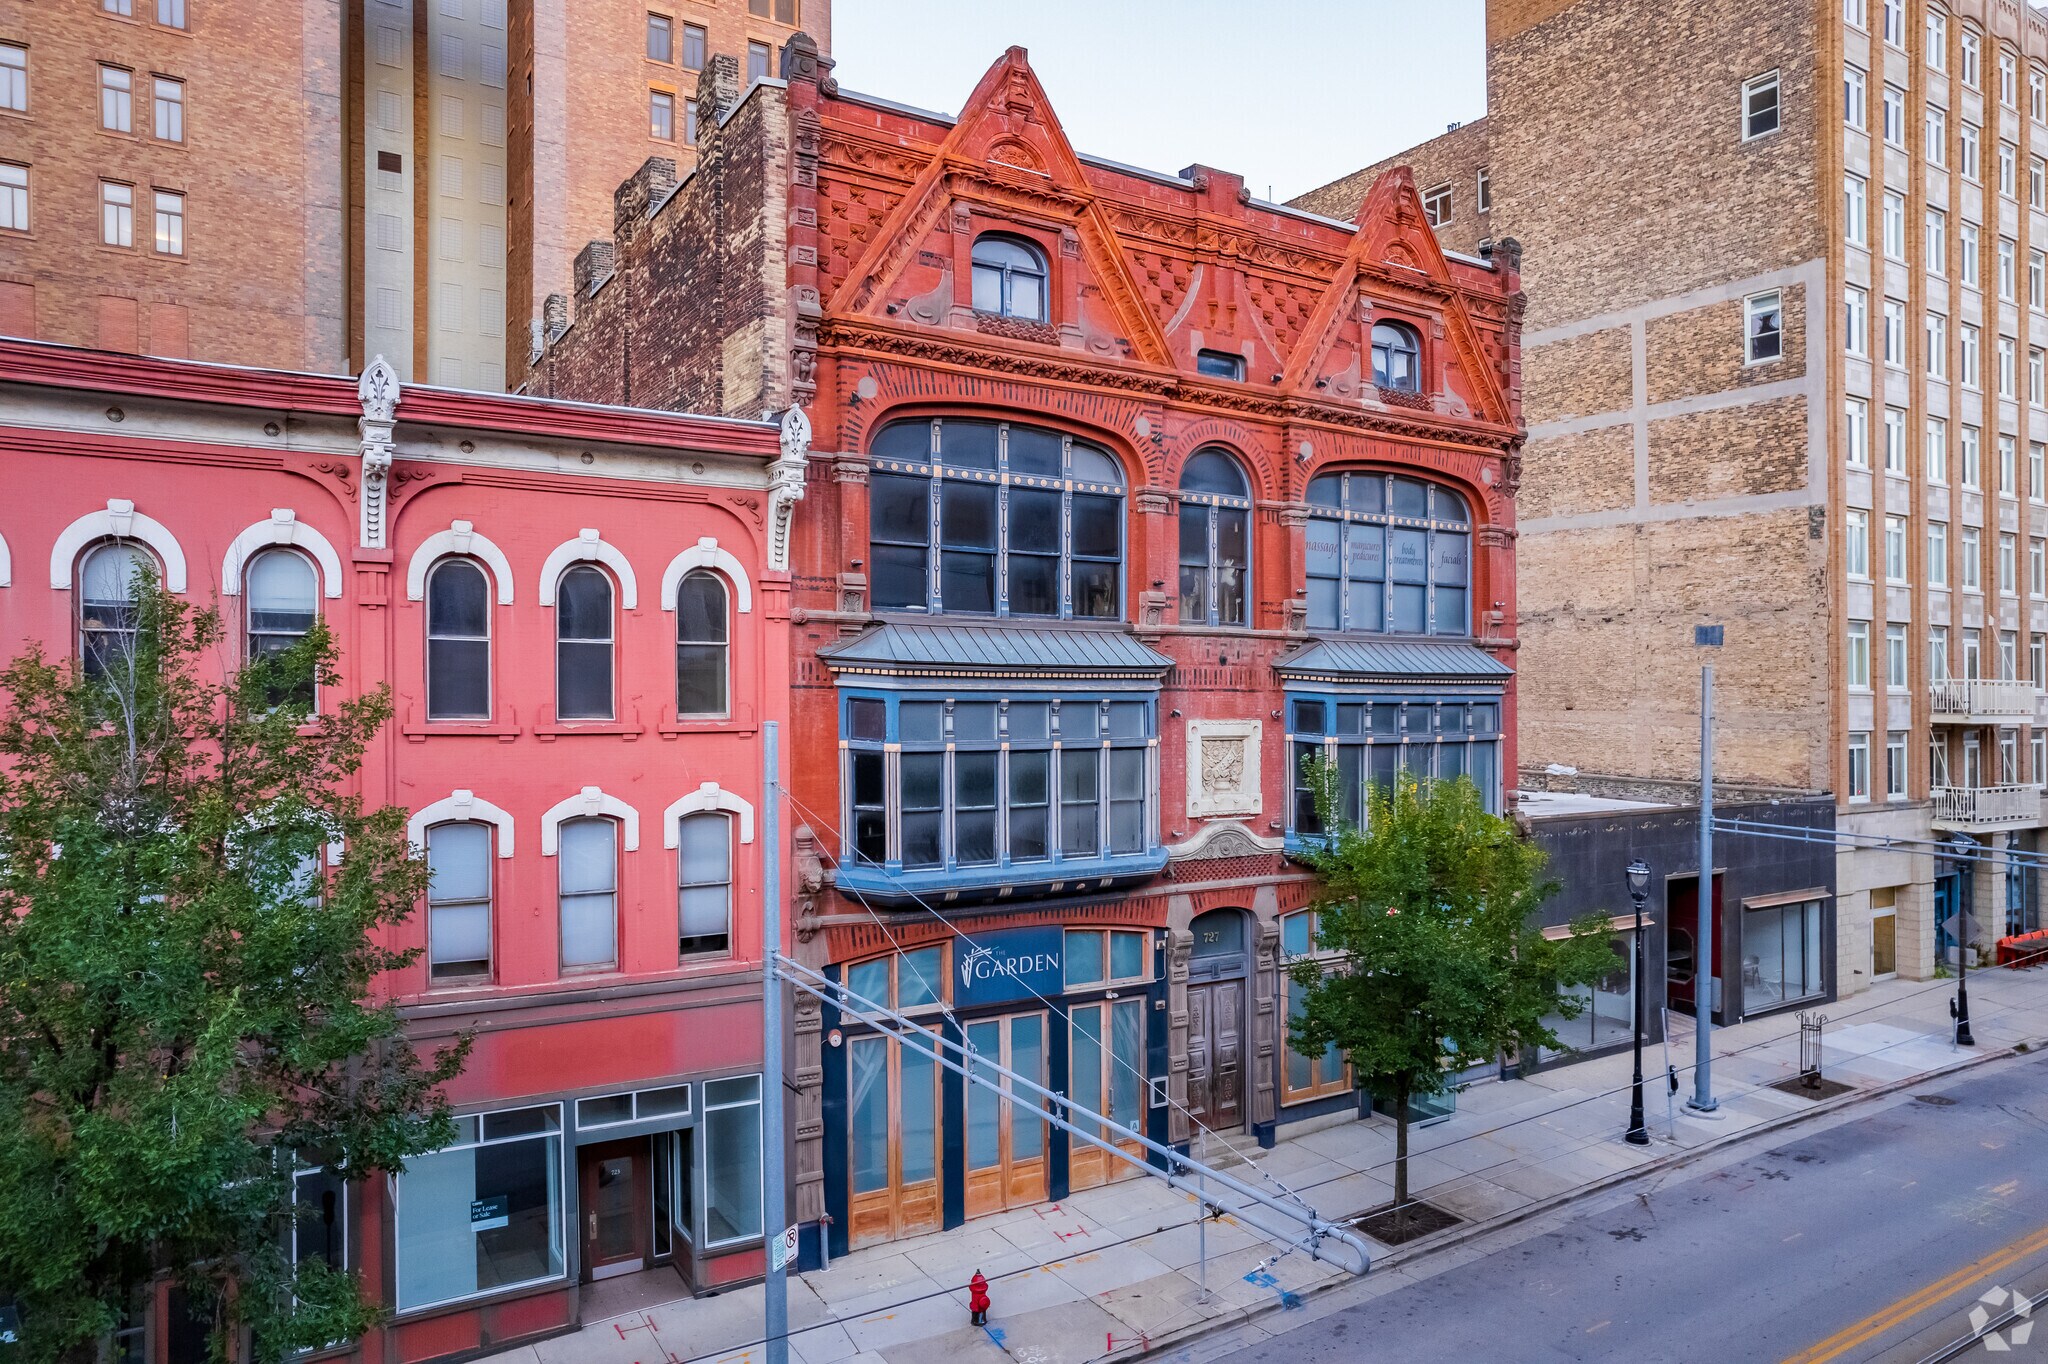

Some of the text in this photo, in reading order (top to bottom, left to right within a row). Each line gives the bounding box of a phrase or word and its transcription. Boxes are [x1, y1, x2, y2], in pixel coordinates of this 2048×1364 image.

[1351, 542, 1381, 551] manicures
[1401, 542, 1415, 557] body
[1351, 549, 1379, 565] pedicures
[1393, 556, 1424, 566] treatments
[1438, 551, 1461, 568] facials
[1203, 931, 1220, 943] 727
[975, 953, 1059, 979] GARDEN
[482, 1204, 498, 1212] Lease
